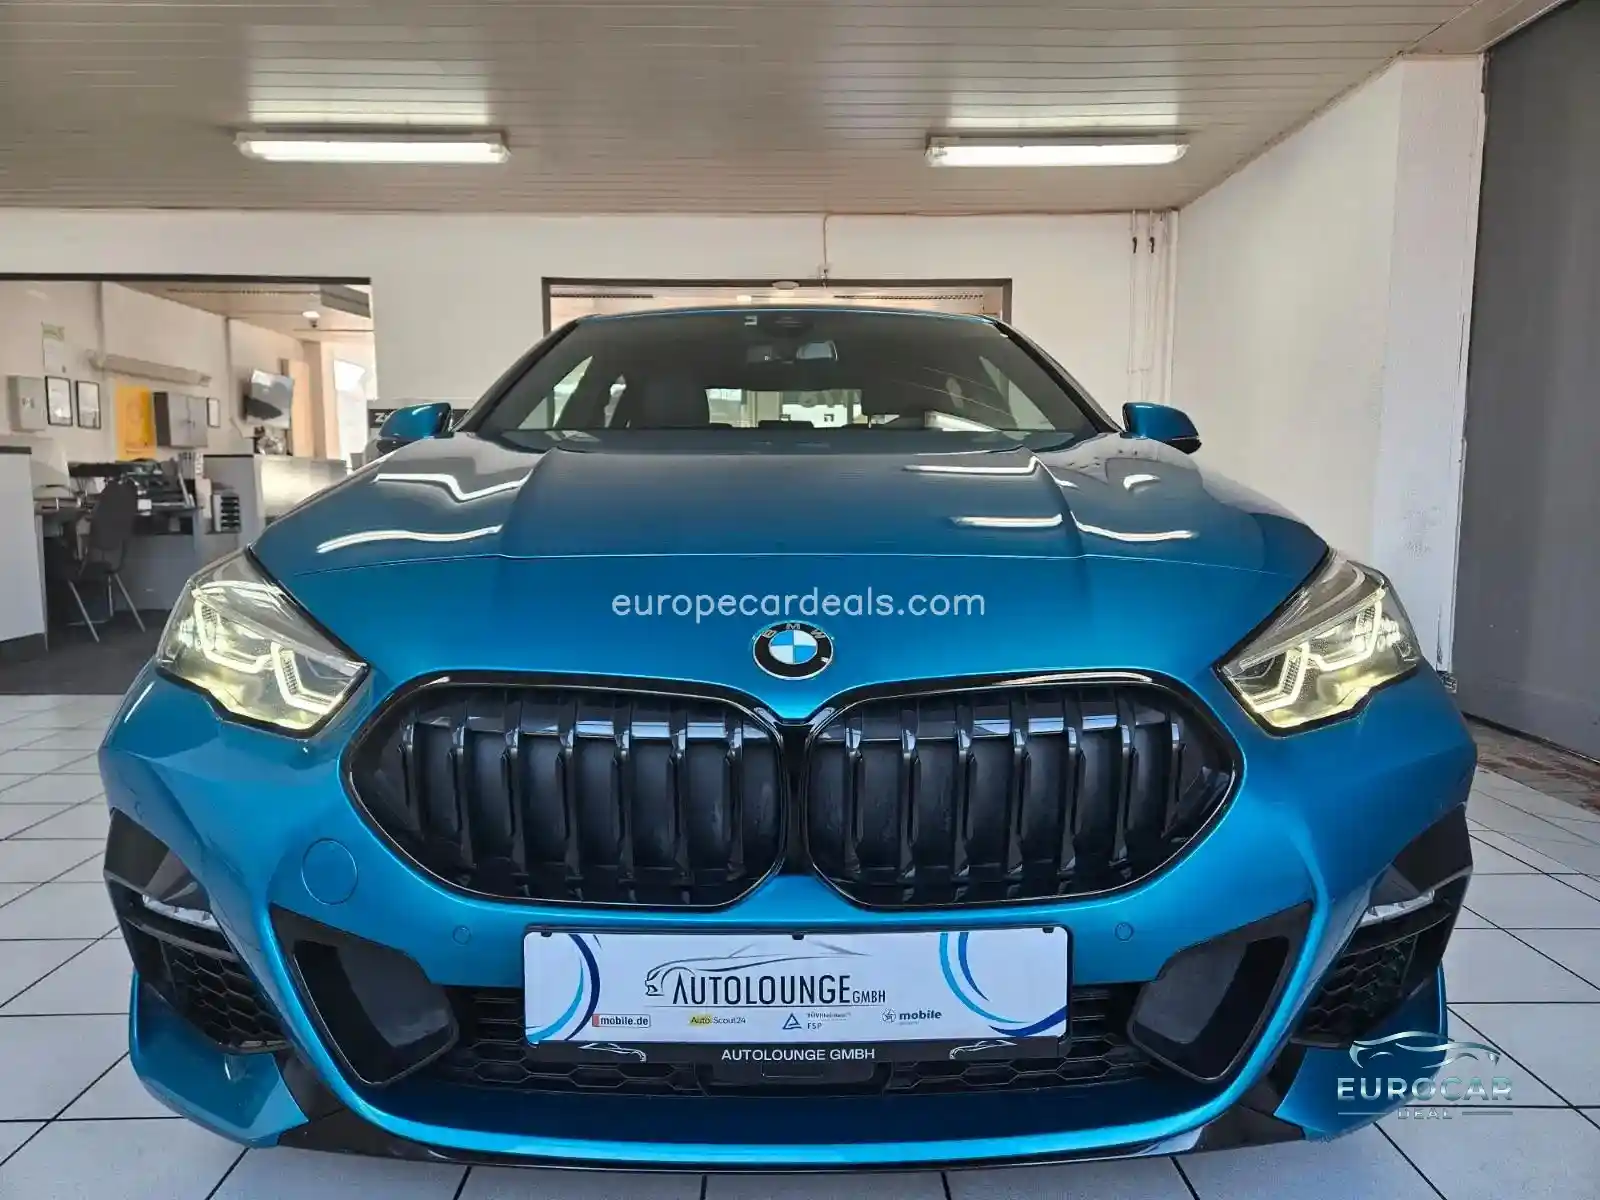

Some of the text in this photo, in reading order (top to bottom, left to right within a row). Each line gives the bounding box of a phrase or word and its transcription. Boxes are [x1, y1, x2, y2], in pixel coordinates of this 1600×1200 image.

[762, 623, 826, 639] BMW
[672, 972, 851, 1005] AUTOLOUNGE
[600, 1016, 649, 1026] mobile.de
[899, 1009, 943, 1021] mobile
[807, 1022, 823, 1030] FSP
[721, 1048, 875, 1061] AUTOLOUNGE GMBH
